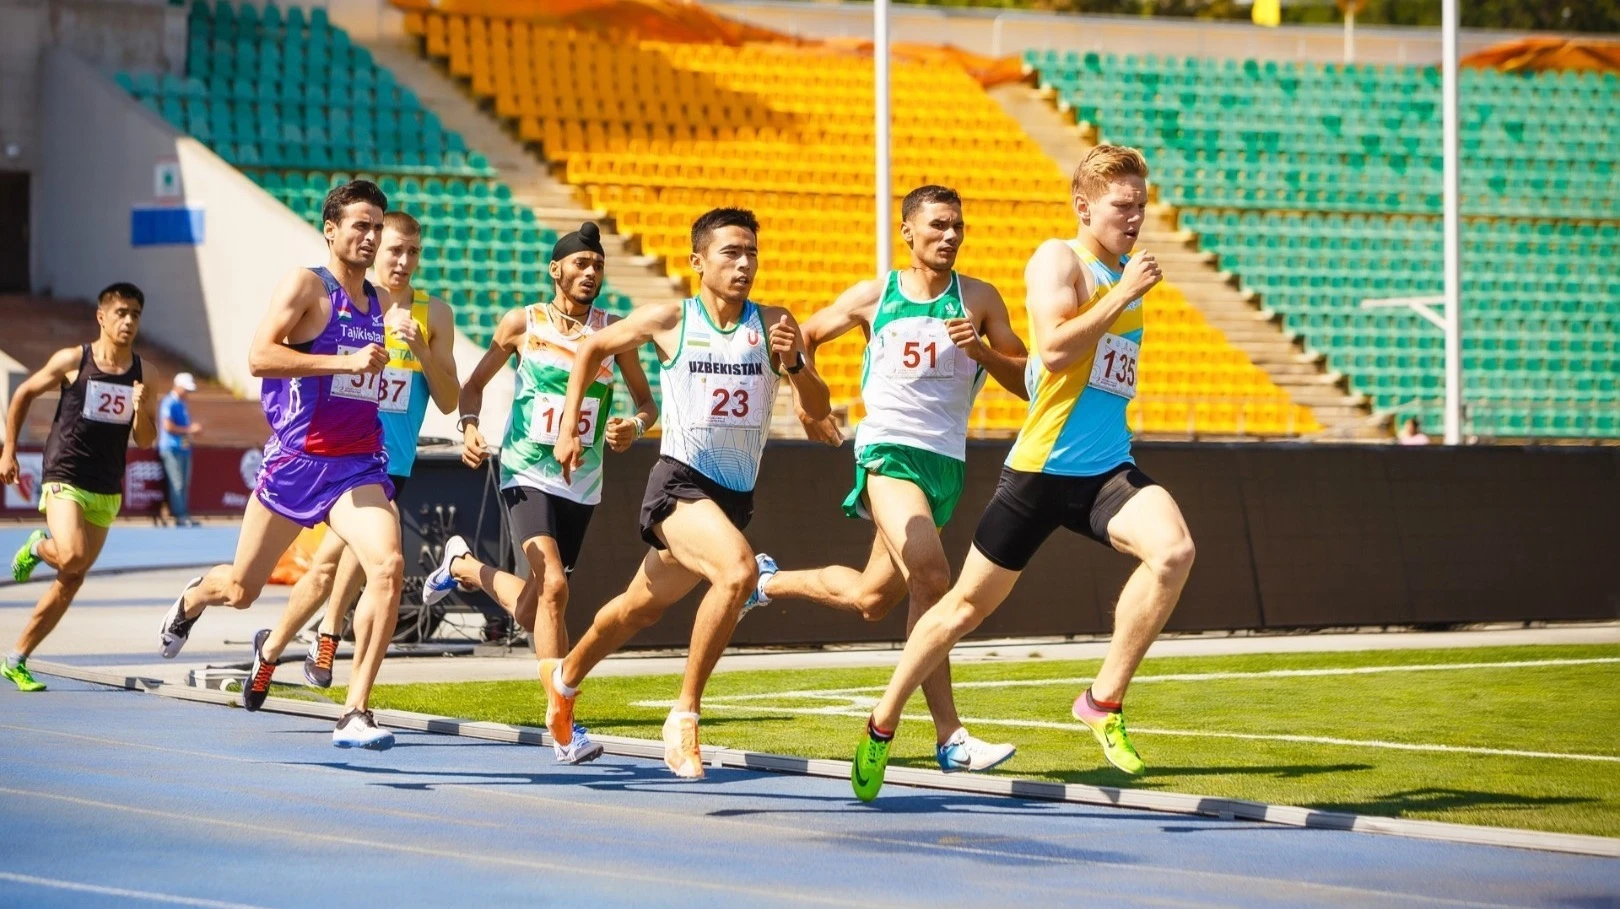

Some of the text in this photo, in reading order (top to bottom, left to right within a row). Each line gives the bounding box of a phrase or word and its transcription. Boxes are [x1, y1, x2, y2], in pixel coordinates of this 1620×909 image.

[340, 324, 385, 342] Tajikistan
[689, 361, 763, 375] UZBEKISTAN
[903, 341, 936, 368] 51
[1104, 350, 1136, 386] 135
[98, 393, 126, 414] 25
[711, 388, 749, 417] 23
[542, 407, 592, 435] 15
